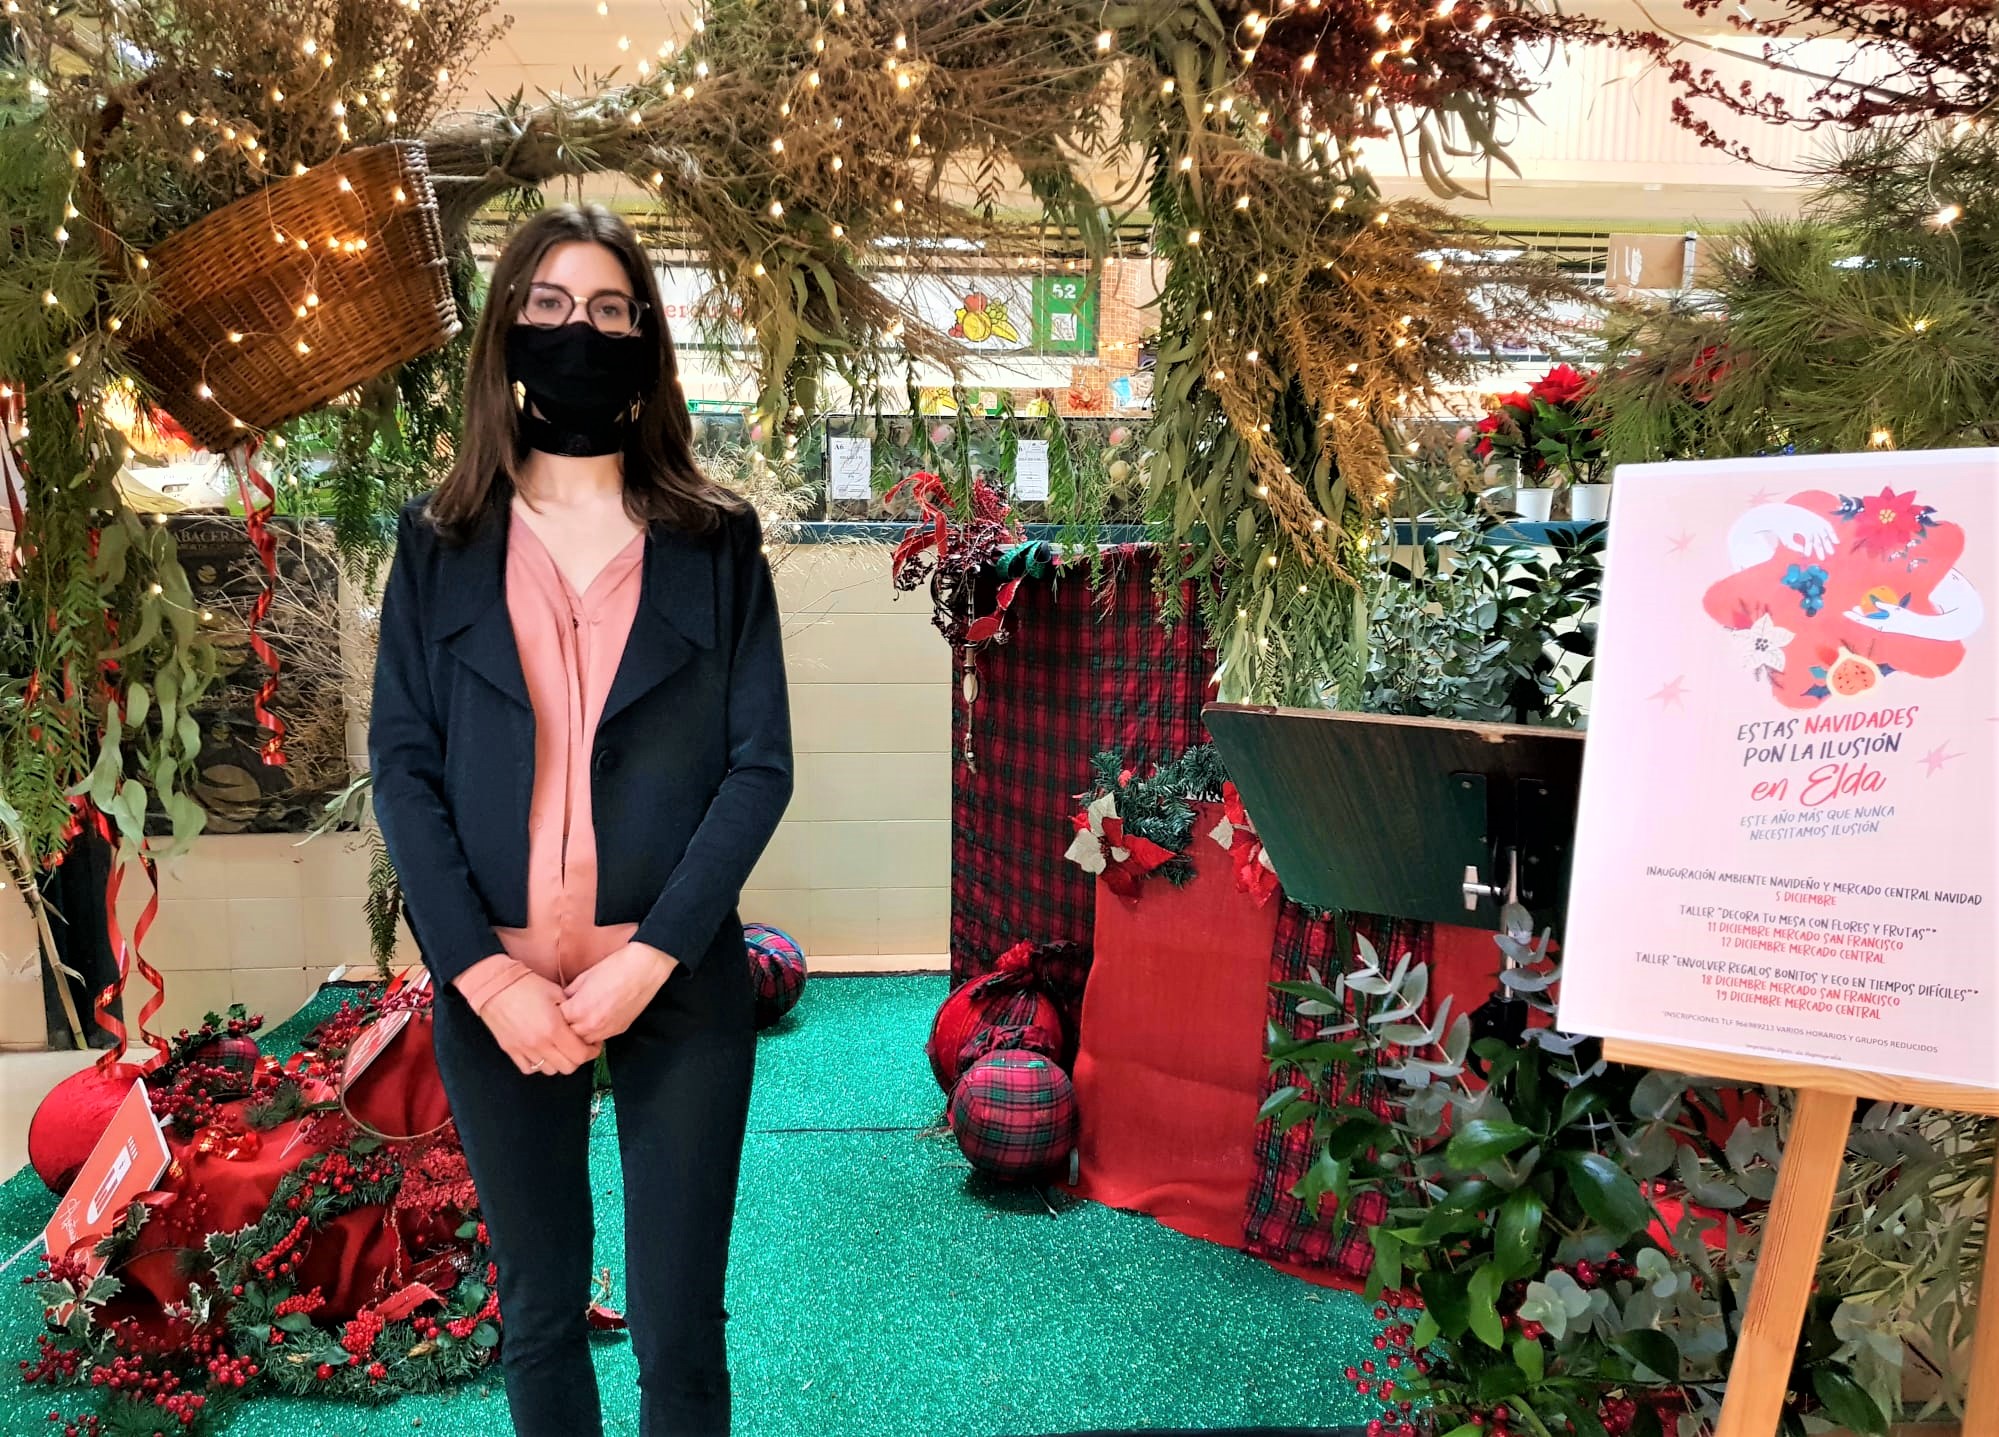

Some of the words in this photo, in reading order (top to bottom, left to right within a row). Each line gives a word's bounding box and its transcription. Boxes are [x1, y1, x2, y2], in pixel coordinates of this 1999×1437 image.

[1737, 718, 1798, 743] ESTAS
[1804, 706, 1918, 734] NAVIDADES
[1744, 743, 1787, 767] PON
[1791, 744, 1813, 761] LA
[1820, 732, 1902, 759] ILUSIÓN
[1751, 778, 1788, 801] en
[1800, 762, 1886, 806] Elda
[1740, 815, 1765, 828] ESTE
[1771, 809, 1795, 824] AÑO
[1798, 808, 1824, 823] MÁS
[1827, 808, 1850, 820] QUE
[1855, 805, 1895, 818] NUNCA
[1750, 825, 1828, 840] NECESITAMOS
[1832, 820, 1879, 836] ILUSIÓN
[1647, 866, 1716, 881] INAUGURACIÓN
[1718, 873, 1767, 885] AMBIENTE
[1770, 876, 1820, 890] NAVIDEÑO
[1824, 882, 1830, 891] Y
[1833, 883, 1881, 895] MERCADO
[1885, 887, 1930, 901] CENTRAL
[1935, 891, 1982, 905] NAVIDAD
[1776, 891, 1780, 901] 5
[1784, 892, 1837, 907] DICIEMBRE
[1680, 904, 1715, 918] TALLER
[1764, 913, 1775, 923] TU
[1779, 914, 1805, 928] MESA
[1809, 918, 1828, 929] CON
[1832, 919, 1870, 934] FLORES
[1873, 924, 1880, 934] Y
[1708, 922, 1716, 932] 11
[1719, 922, 1770, 937] DICIEMBRE
[1773, 928, 1820, 941] MERCADO
[1824, 933, 1844, 944] SAN
[1847, 934, 1903, 950] FRANCISCO
[1722, 937, 1731, 947] 12
[1734, 938, 1785, 952] DICIEMBRE
[1789, 943, 1836, 957] MERCADO
[1840, 949, 1885, 964] CENTRAL
[1636, 952, 1670, 966] TALLER
[1729, 962, 1772, 978] REGALOS
[1775, 968, 1818, 984] BONITOS
[1822, 974, 1828, 984] Y
[1831, 975, 1849, 985] ECO
[1852, 977, 1866, 987] EN
[1871, 979, 1915, 995] TIEMPOS
[1702, 974, 1712, 985] 18
[1716, 975, 1767, 990] DICIEMBRE
[1770, 982, 1816, 995] MERCADO
[1820, 988, 1841, 999] SAN
[1844, 989, 1900, 1007] FRANCISCO
[1717, 990, 1727, 1000] 19
[1730, 991, 1781, 1007] DICIEMBRE
[1785, 998, 1832, 1012] MERCADO
[1836, 1004, 1881, 1019] CENTRAL
[1777, 1026, 1803, 1036] VARIOS
[1806, 1030, 1847, 1041] HORARIOS
[1855, 1036, 1888, 1047] GRUPOS
[1890, 1041, 1938, 1053] REDUCIDOS
